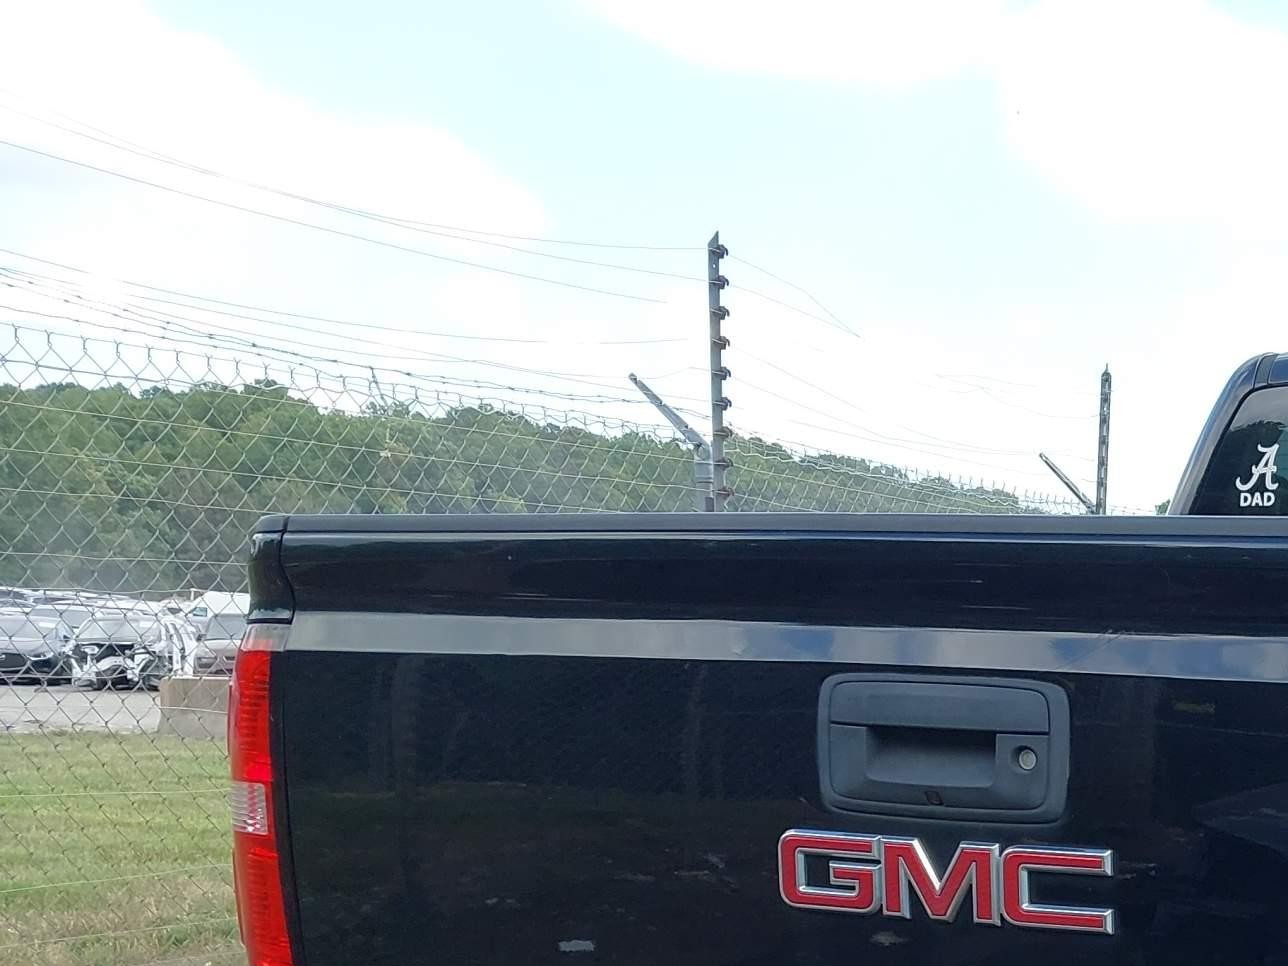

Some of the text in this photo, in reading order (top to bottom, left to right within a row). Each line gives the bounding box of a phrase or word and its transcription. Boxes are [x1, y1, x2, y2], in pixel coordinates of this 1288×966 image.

[1235, 443, 1280, 491] A
[1239, 491, 1276, 507] DAD
[778, 829, 1114, 935] GMC
